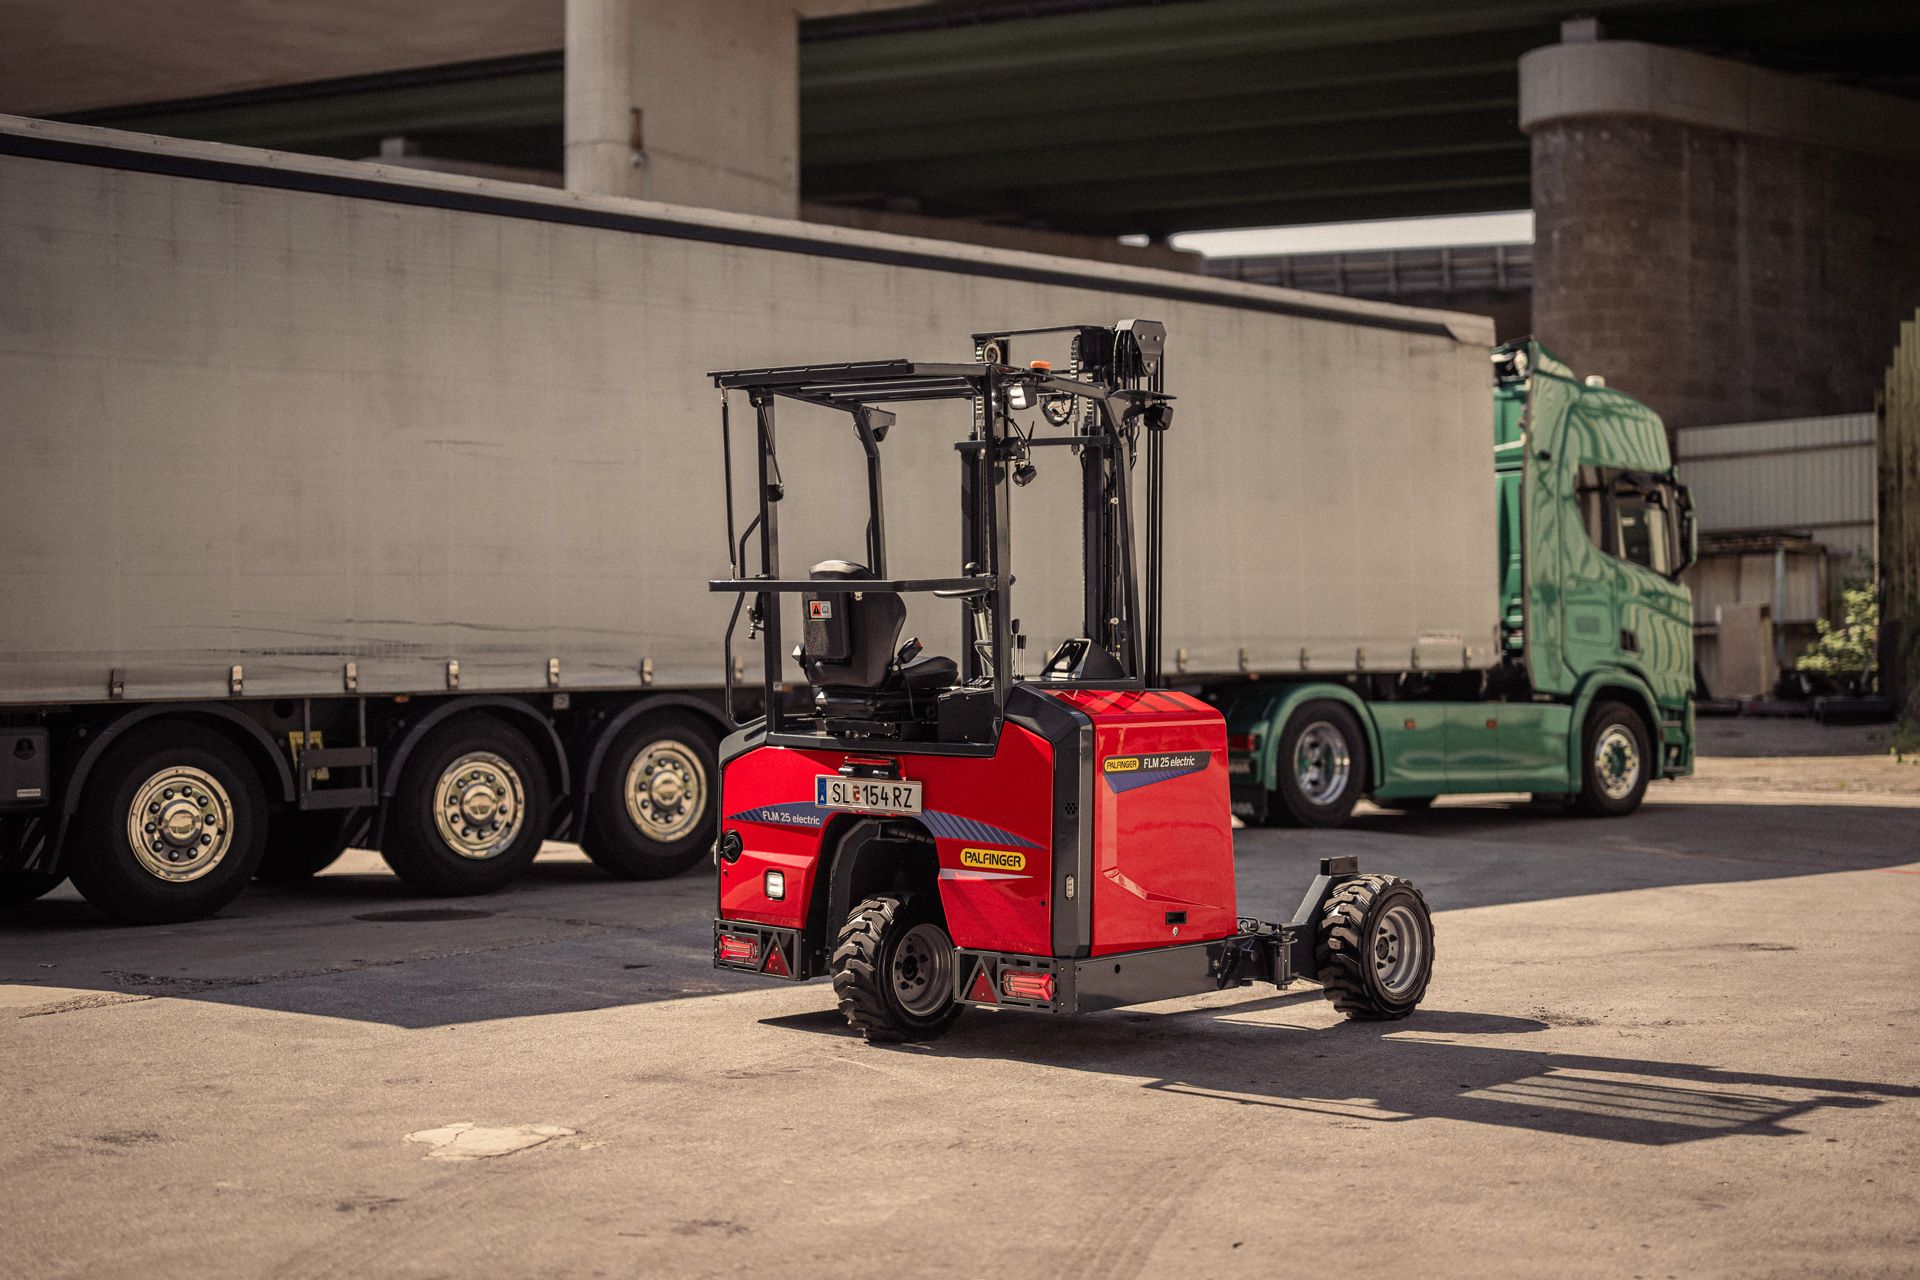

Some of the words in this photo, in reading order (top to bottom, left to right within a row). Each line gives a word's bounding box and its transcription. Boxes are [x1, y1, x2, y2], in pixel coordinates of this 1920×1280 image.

[1106, 760, 1137, 770] PALFINGER
[1143, 758, 1159, 769] FLM
[1160, 757, 1170, 768] 25
[1170, 756, 1196, 767] electric
[832, 783, 850, 804] SL
[863, 785, 889, 807] 154
[893, 787, 913, 809] RZ
[762, 811, 780, 821] FLM
[780, 812, 791, 822] 25
[792, 814, 820, 825] electric
[964, 851, 1021, 867] PALFINGER
